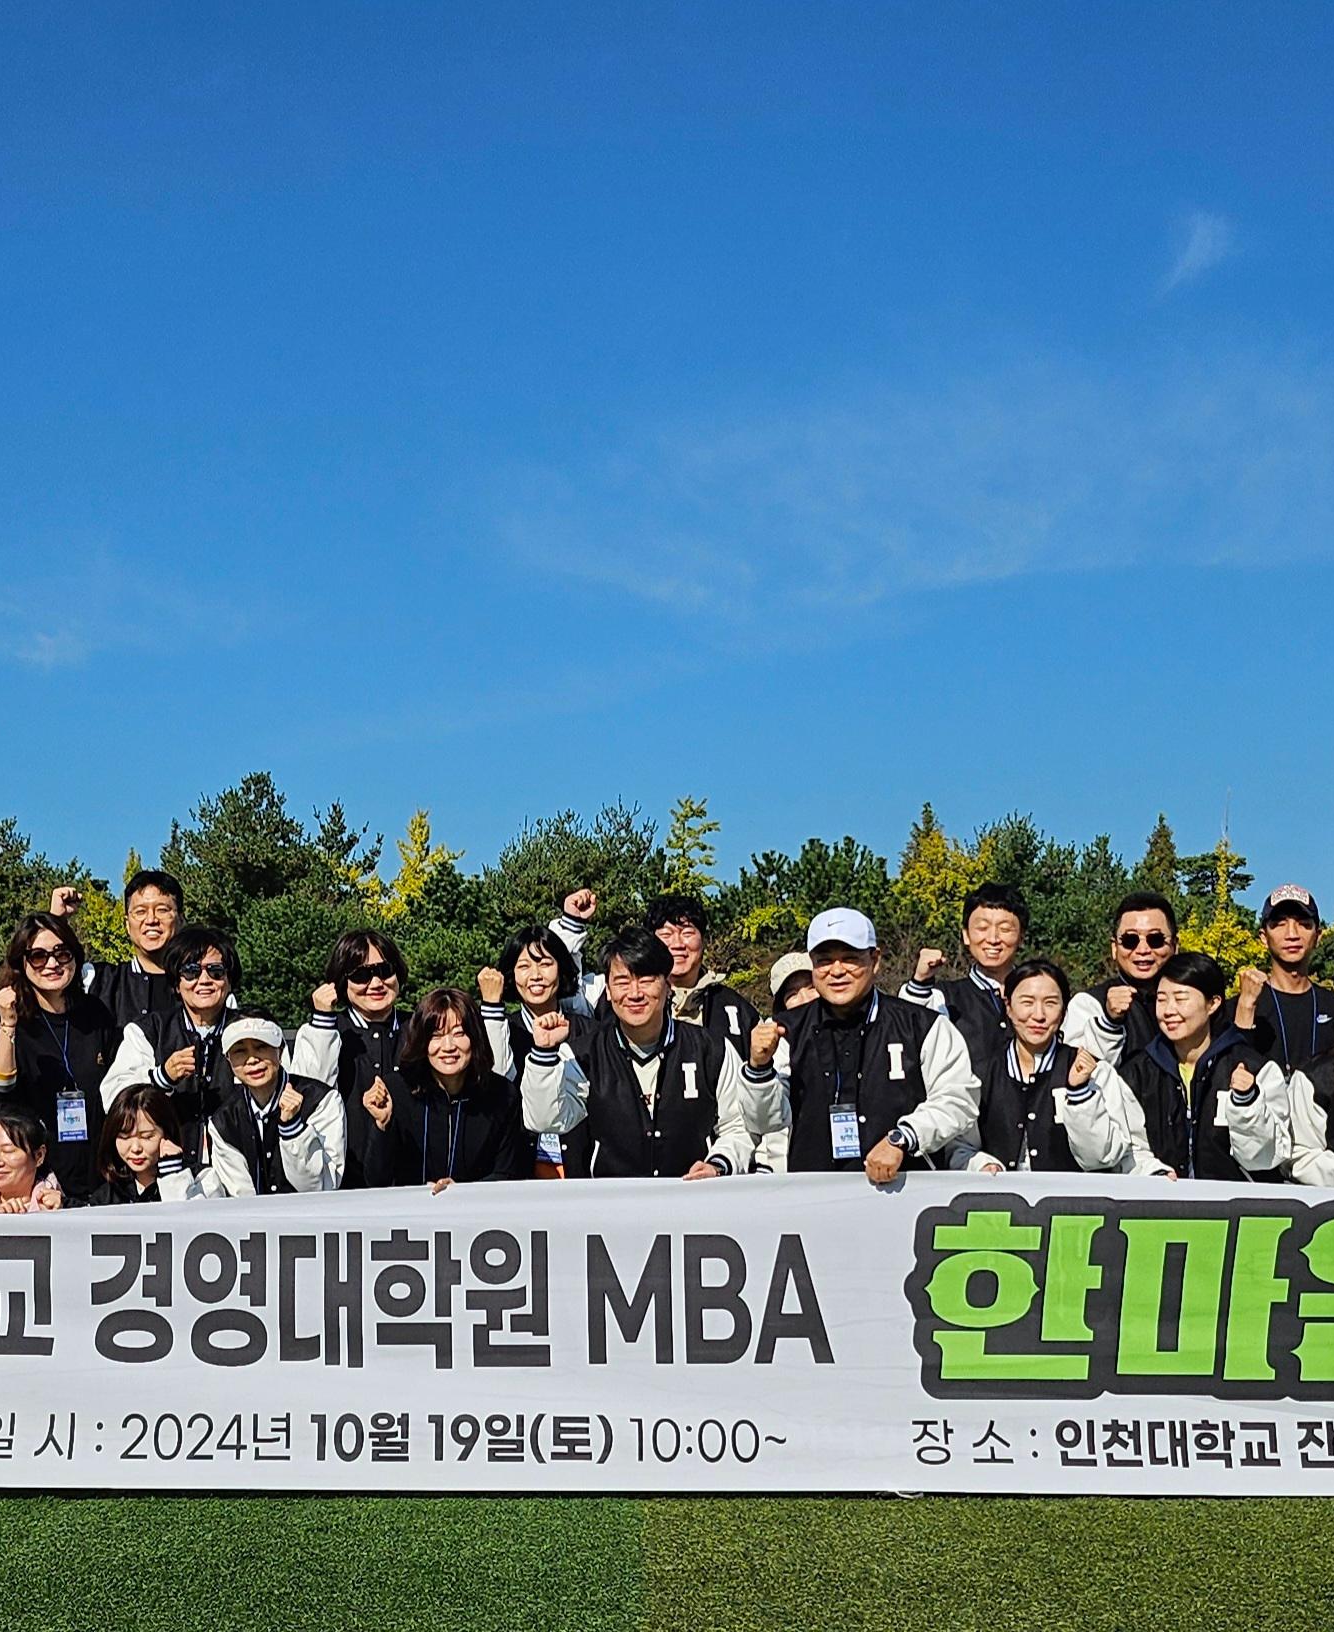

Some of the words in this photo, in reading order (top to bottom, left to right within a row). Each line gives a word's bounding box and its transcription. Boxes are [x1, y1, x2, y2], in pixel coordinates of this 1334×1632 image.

[682, 1062, 699, 1099] I
[888, 1043, 906, 1080] I
[90, 1229, 552, 1370] 경영대학원
[586, 1234, 836, 1365] MBA
[120, 1412, 292, 1461] 2024년
[310, 1413, 410, 1462] 10월
[427, 1413, 615, 1465] 19일(토)
[629, 1418, 788, 1463] 10:00~
[1055, 1419, 1282, 1469] 인천대학교
